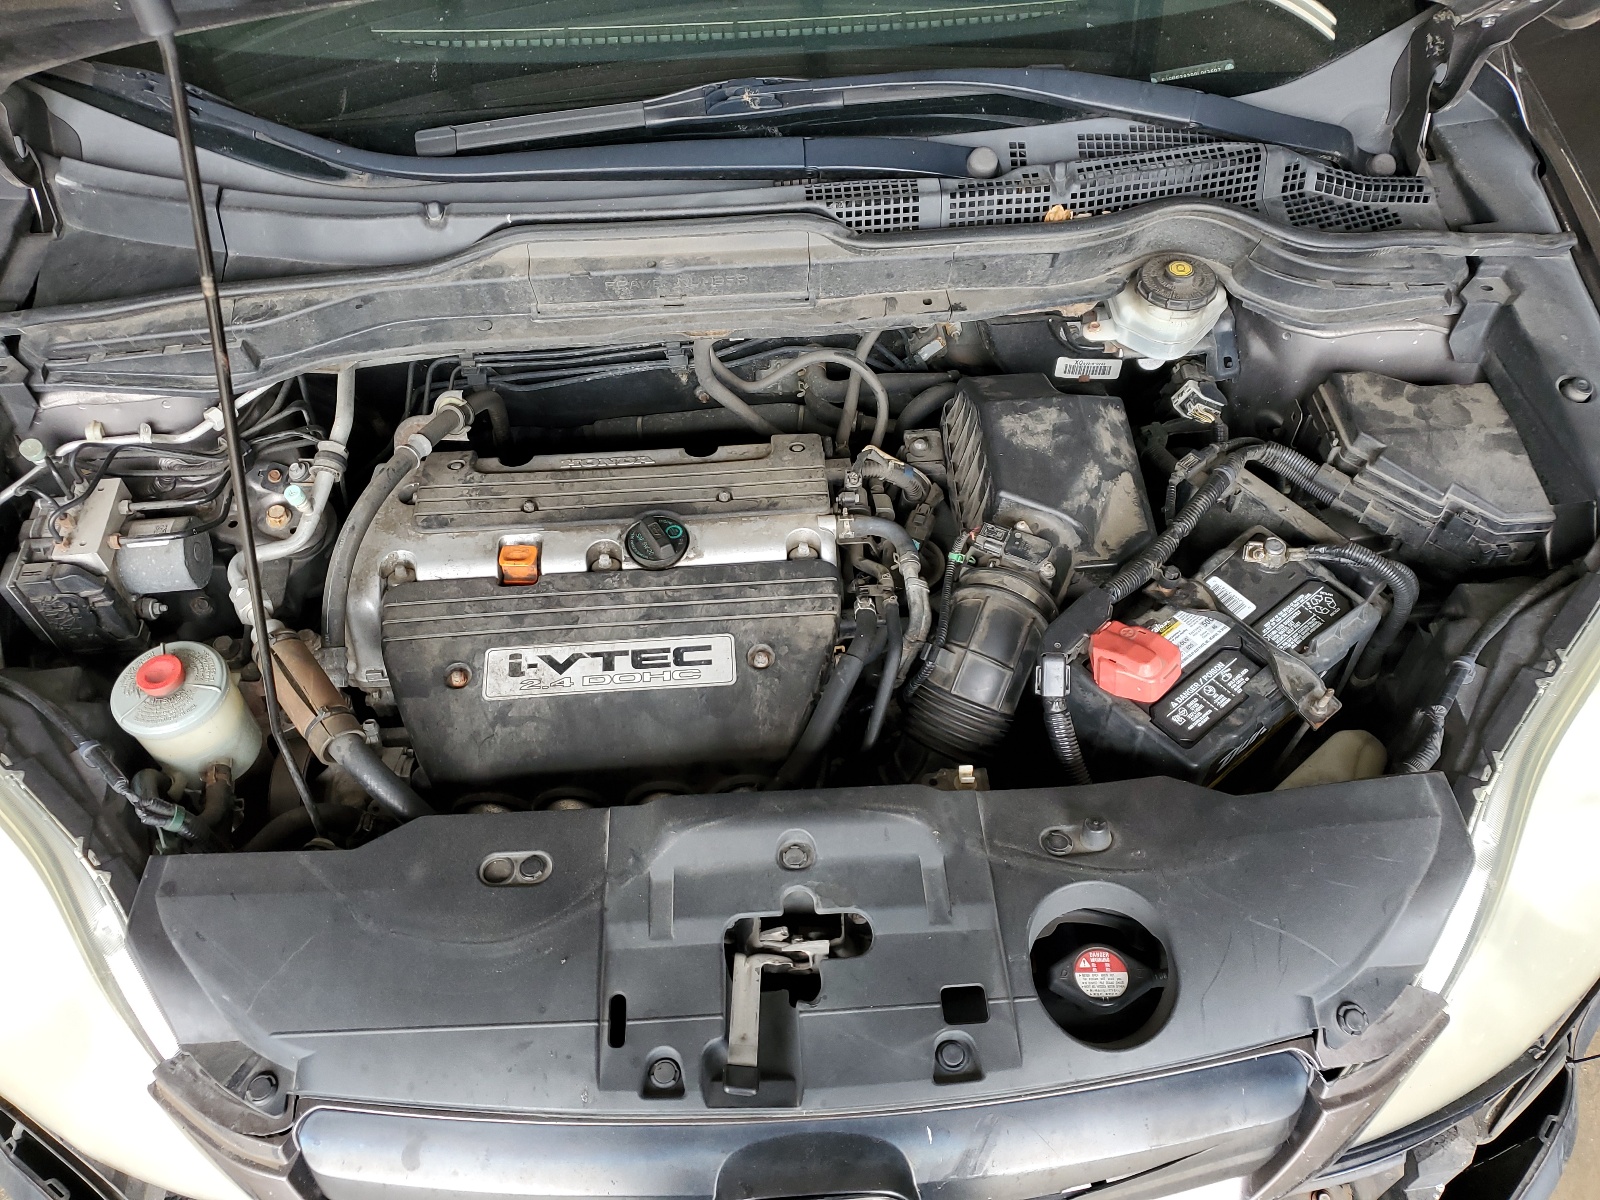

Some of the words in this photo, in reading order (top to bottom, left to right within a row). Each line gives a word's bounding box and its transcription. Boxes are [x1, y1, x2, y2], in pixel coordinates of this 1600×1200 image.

[560, 456, 656, 469] HONDA
[508, 644, 713, 678] i-VTEC
[519, 676, 574, 691] 2.4
[582, 668, 702, 687] DOHC
[1174, 681, 1201, 704] DANGER
[1202, 661, 1226, 682] POISON
